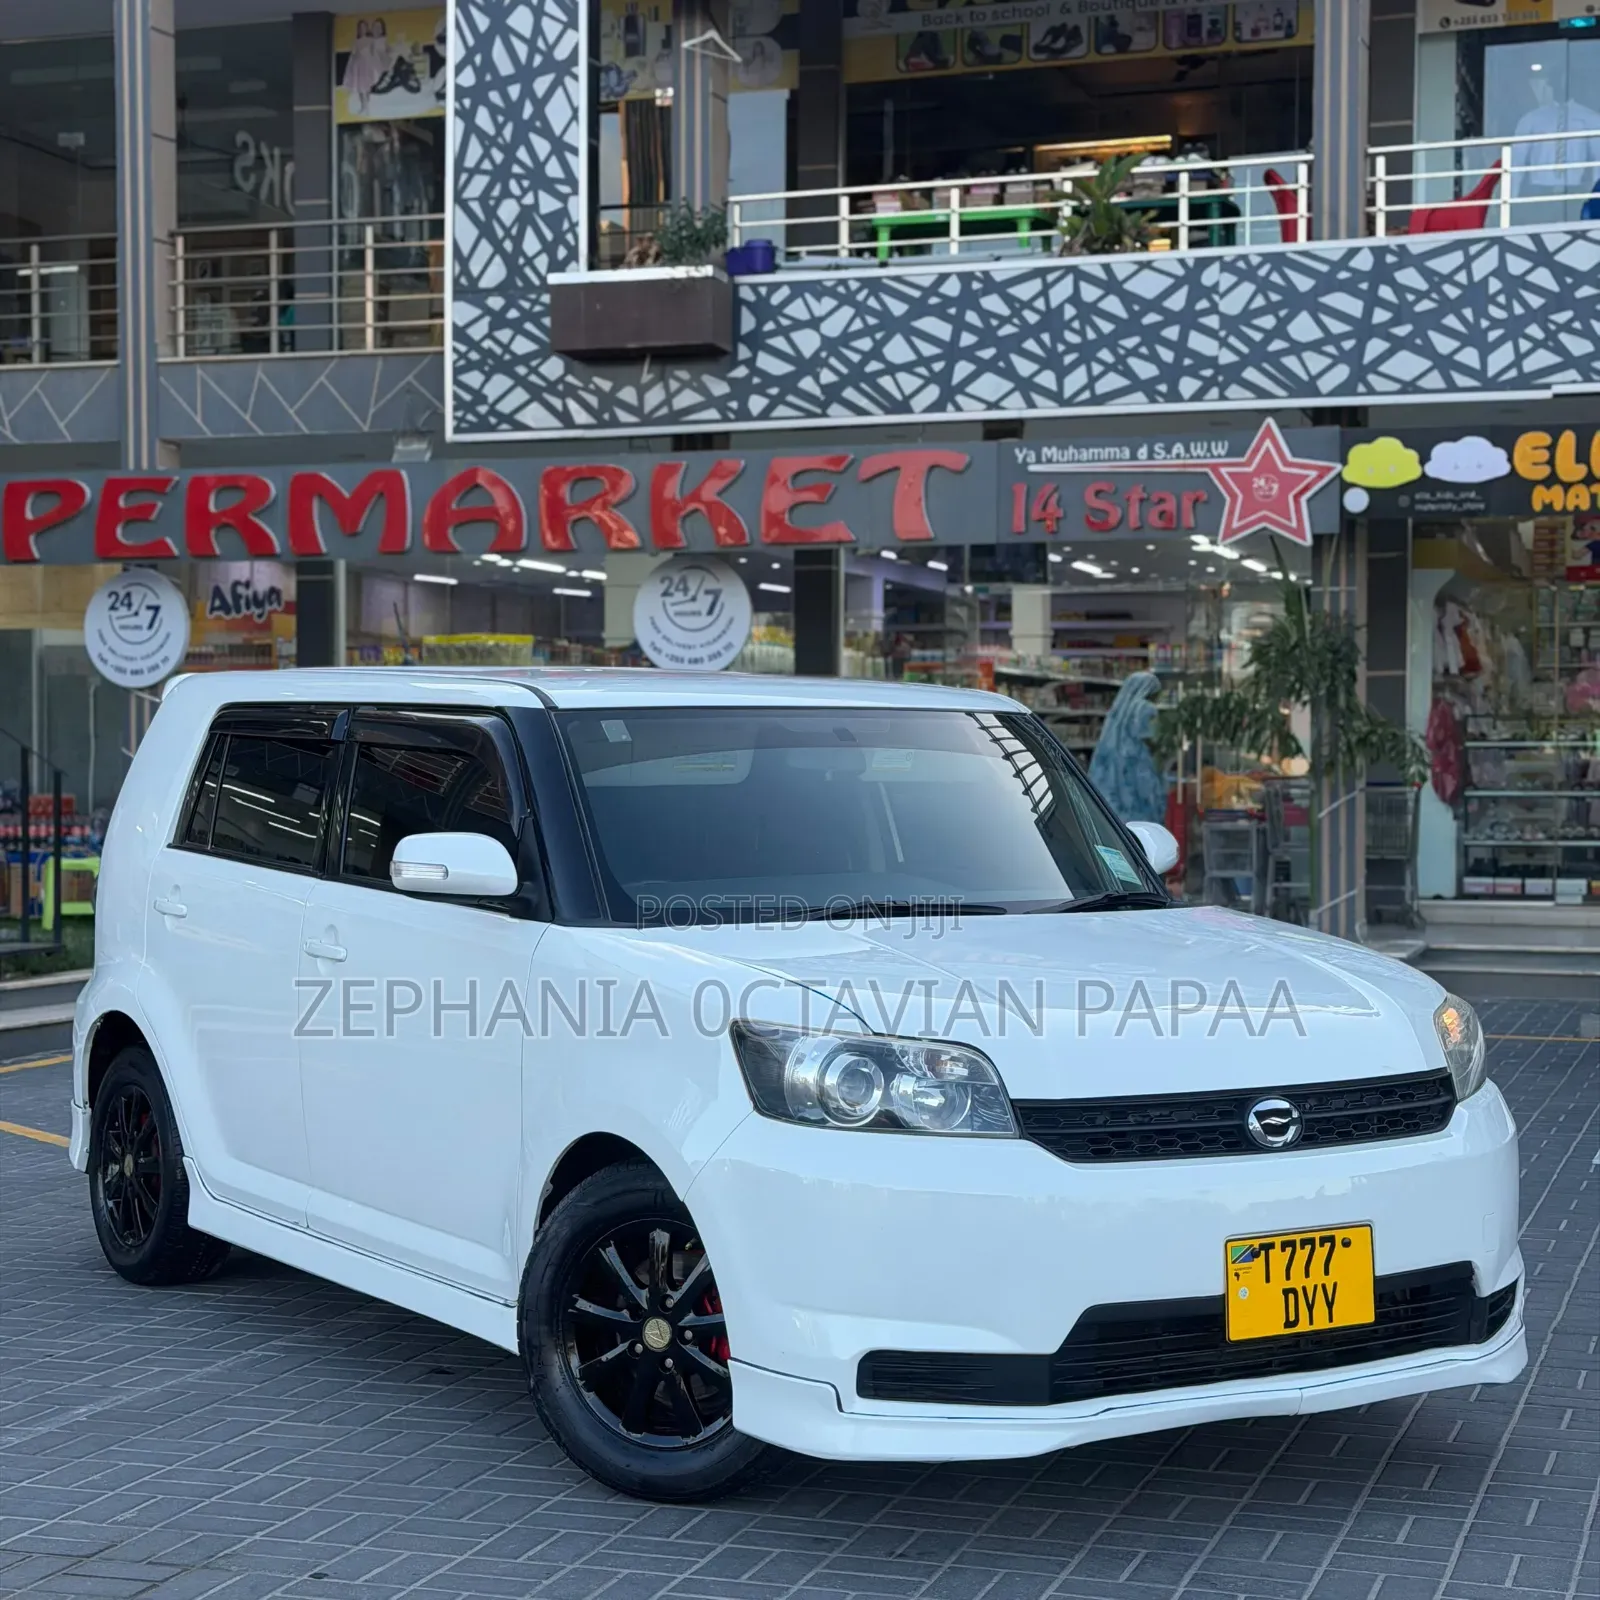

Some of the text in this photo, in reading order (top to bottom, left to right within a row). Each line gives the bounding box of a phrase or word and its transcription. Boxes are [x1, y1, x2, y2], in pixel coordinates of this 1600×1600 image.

[921, 12, 965, 28] Back
[969, 9, 987, 23] to
[991, 3, 1050, 21] school
[1059, 2, 1073, 15] &
[1014, 447, 1036, 464] Ya
[1041, 445, 1131, 463] Muhamma
[1137, 443, 1148, 460] d
[3, 450, 970, 562] PERMARKET
[1012, 482, 1208, 535] 14 Star
[208, 580, 282, 620] Afiya
[1259, 1234, 1337, 1284] T777
[1281, 1280, 1338, 1330] DYY
